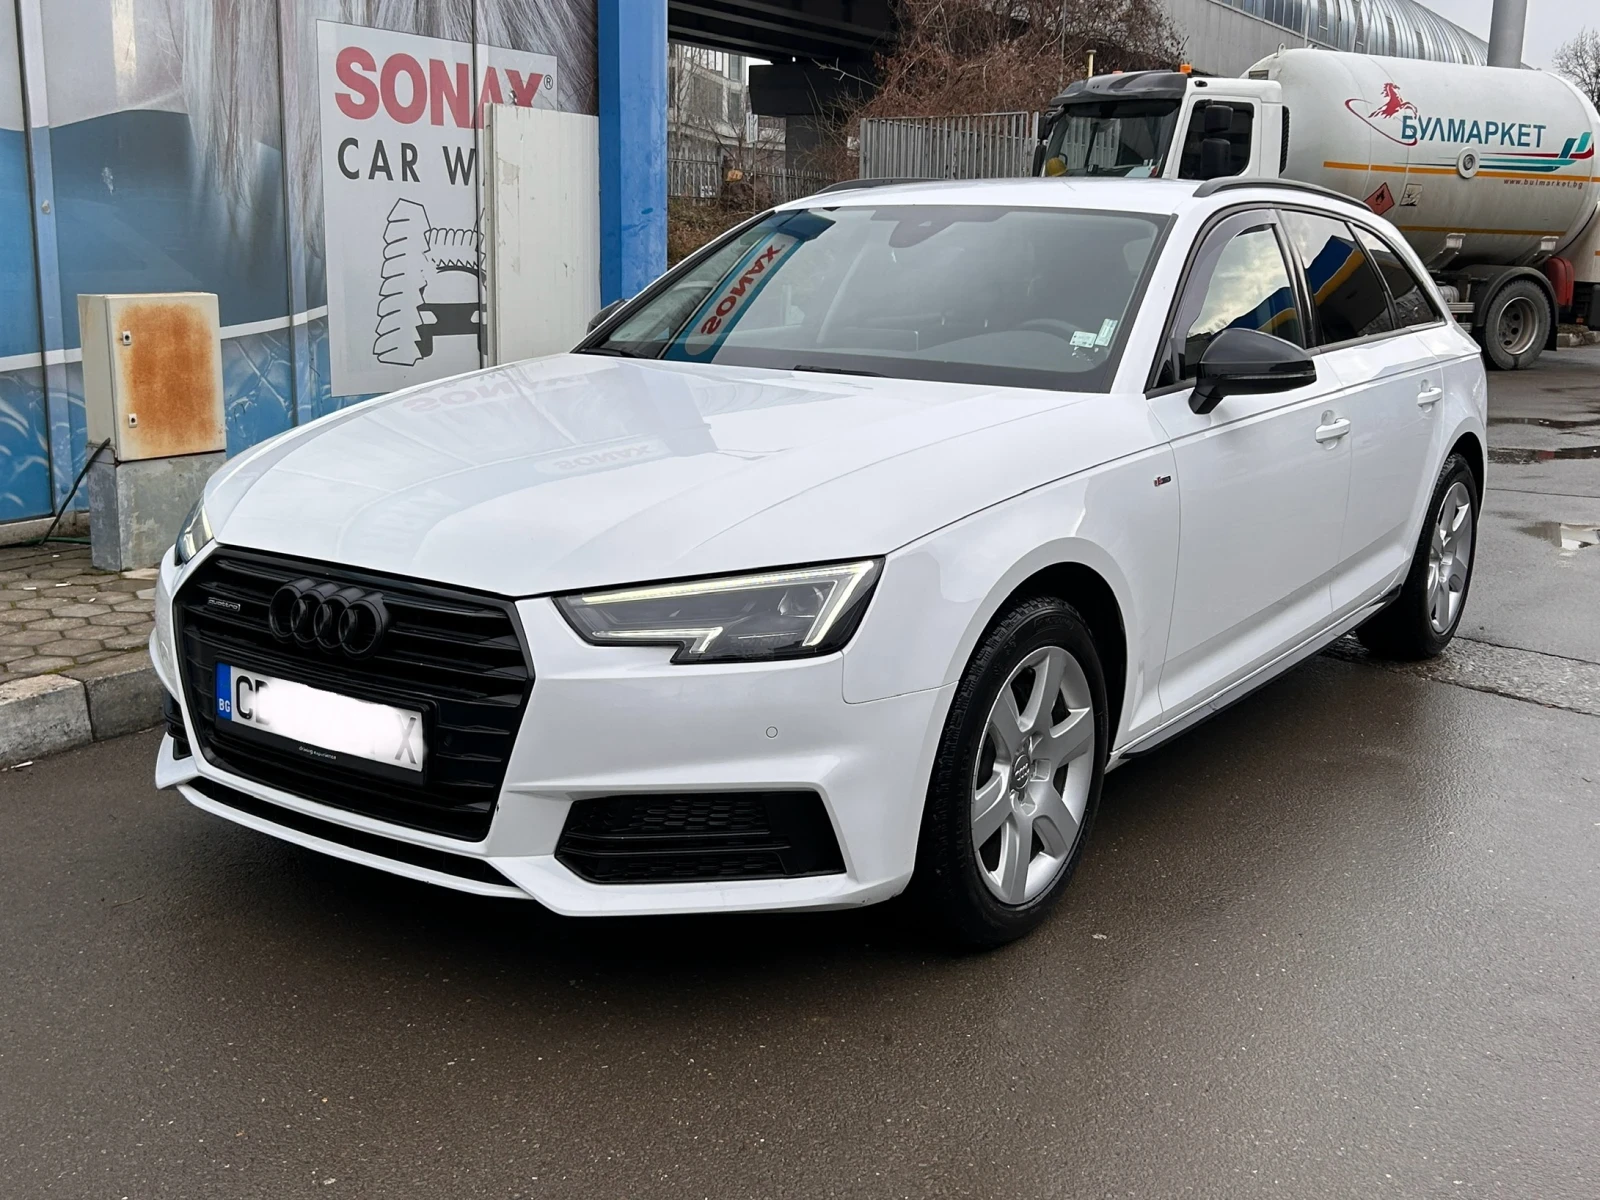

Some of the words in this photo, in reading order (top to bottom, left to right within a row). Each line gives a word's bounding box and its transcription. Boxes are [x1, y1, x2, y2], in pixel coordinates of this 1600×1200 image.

[1401, 115, 1546, 148] БУЛМАРКЕТ
[337, 137, 420, 183] CAR
[1503, 178, 1583, 190] www.bulmarket.bg
[219, 698, 231, 712] BG
